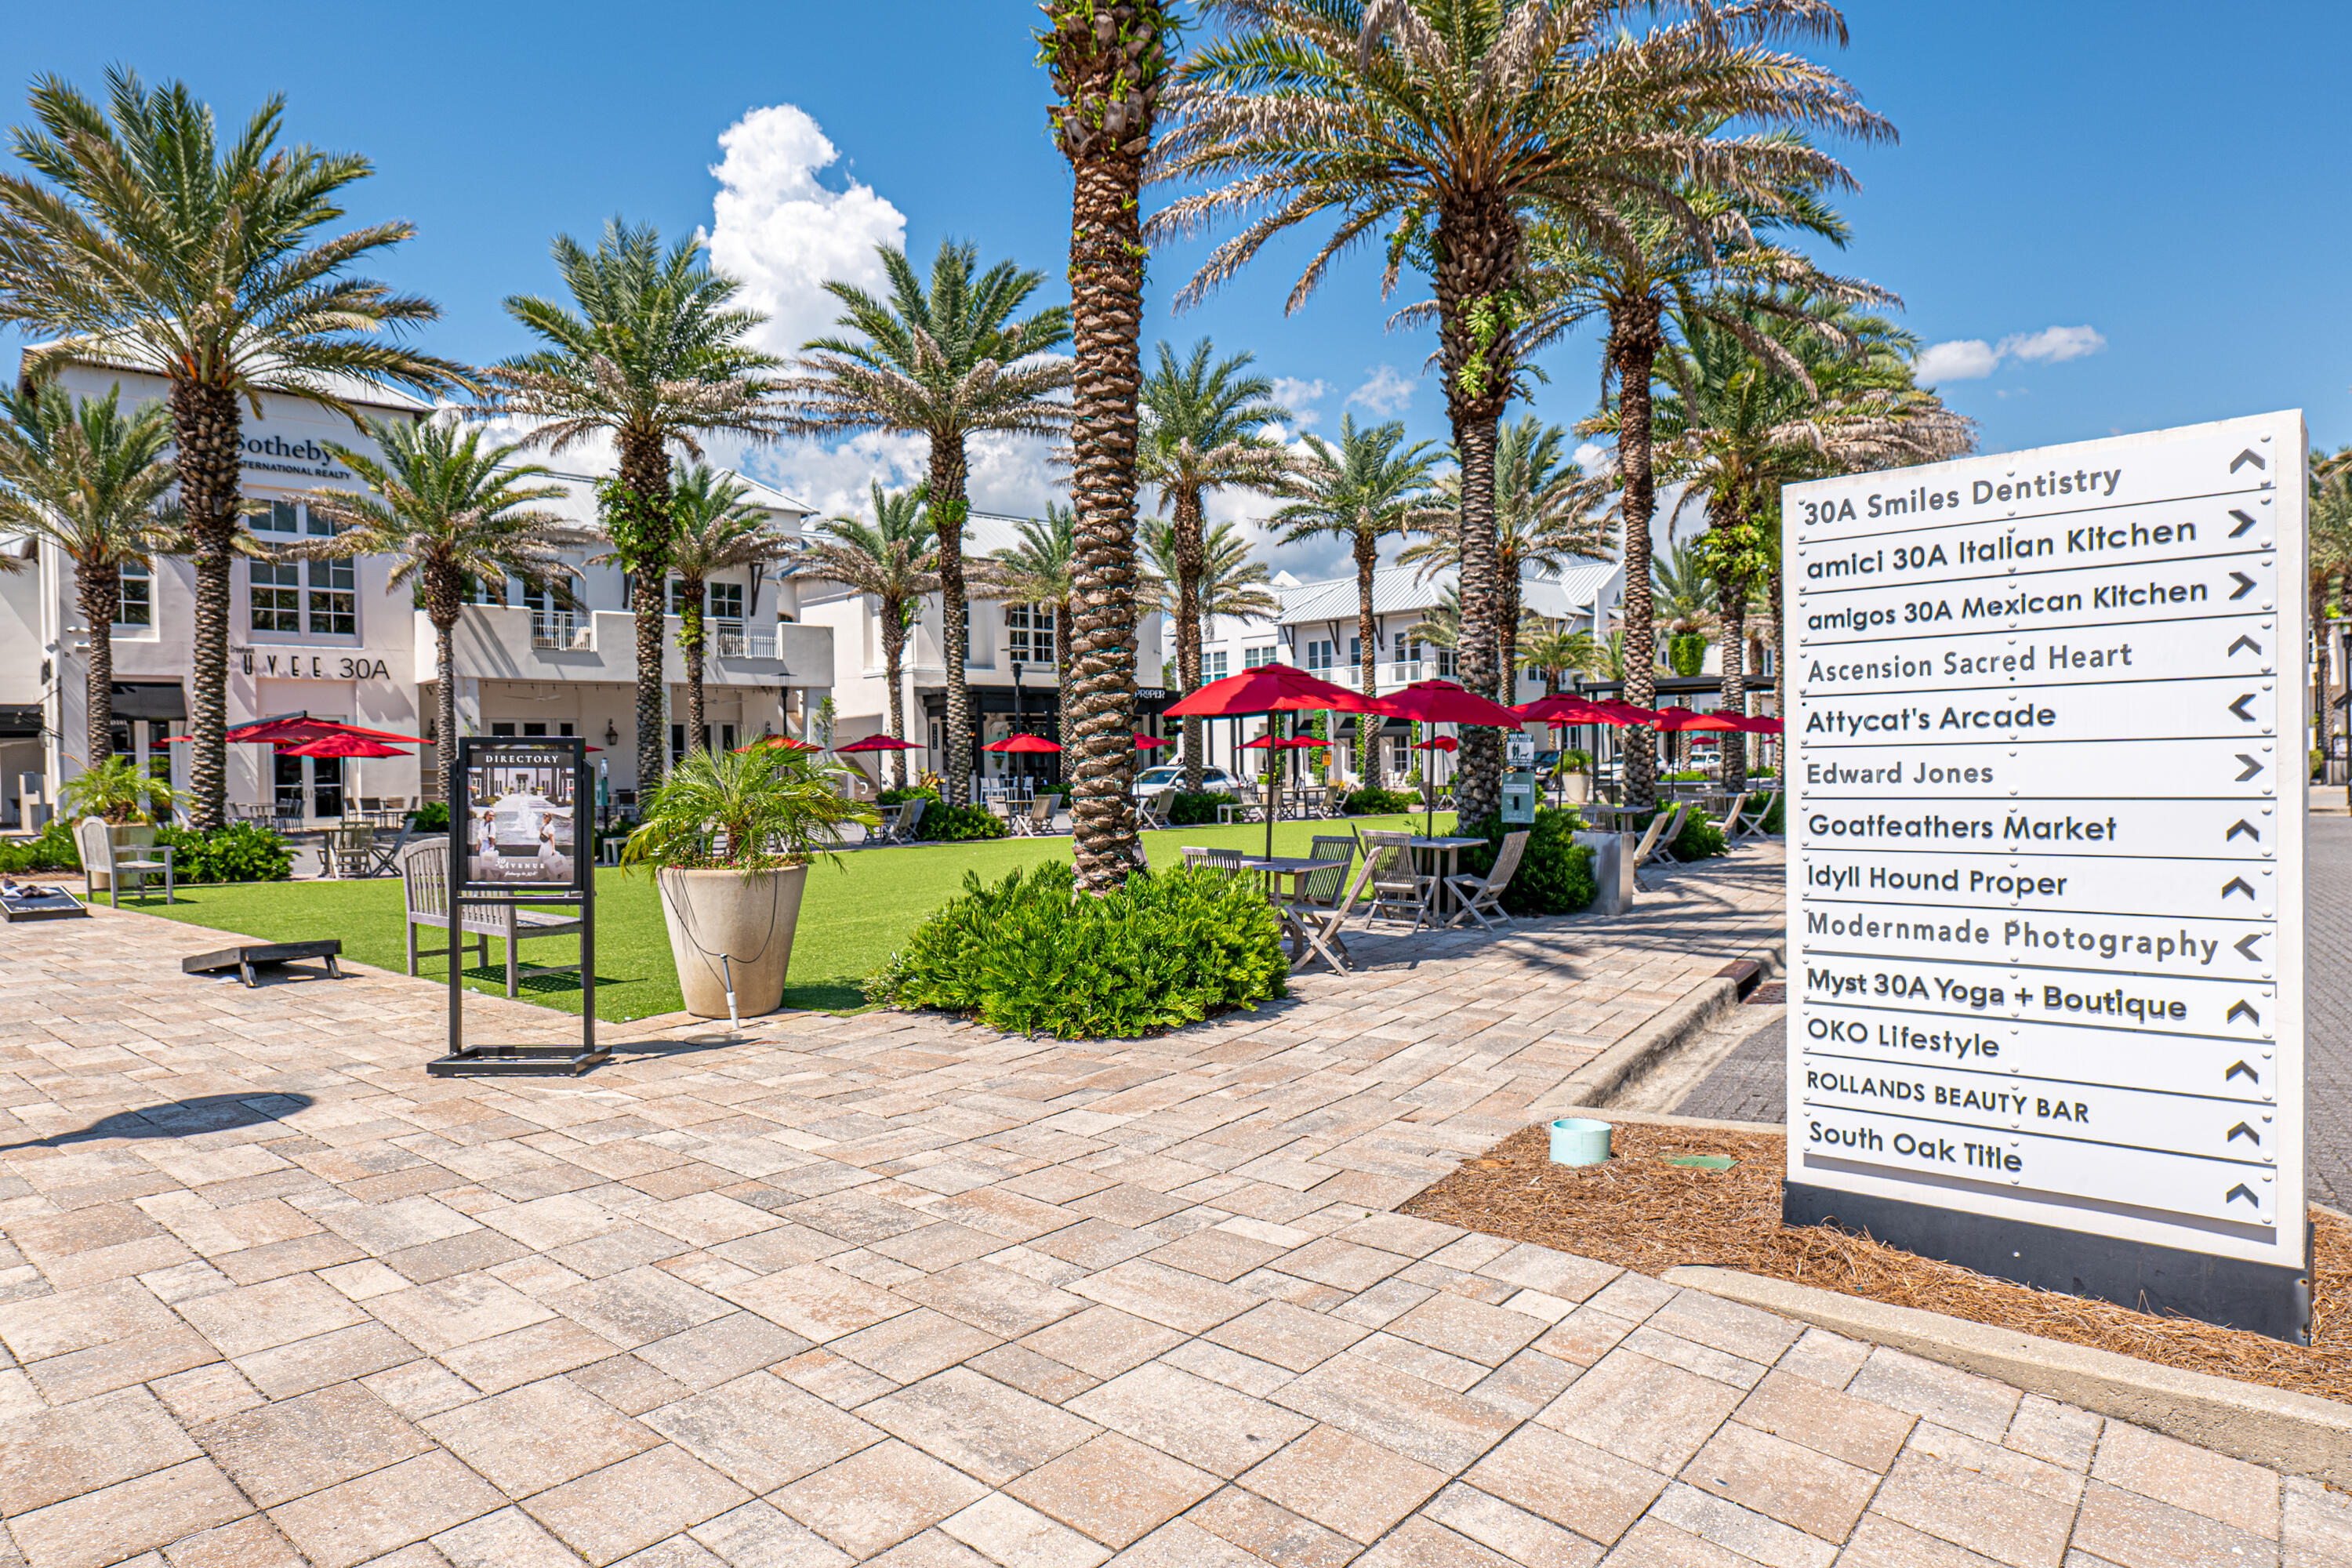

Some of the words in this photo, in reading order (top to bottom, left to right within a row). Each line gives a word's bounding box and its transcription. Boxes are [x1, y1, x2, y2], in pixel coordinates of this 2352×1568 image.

[238, 460, 313, 476] TERNATIONAL
[315, 469, 351, 480] REALTY
[1805, 499, 1857, 525] 30A
[1868, 487, 1958, 517] Smiles
[1973, 470, 2121, 504] Dentistry
[1807, 550, 1882, 579] amici
[1893, 544, 1947, 570] 30A
[1960, 535, 2053, 564] Italian
[2068, 523, 2196, 553] Kitchen
[1808, 608, 1895, 631] amigos
[1904, 601, 1952, 622] 30A
[1962, 593, 2082, 619] Mexican
[2094, 583, 2207, 608] Kitchen
[339, 658, 390, 681] 30A
[1808, 655, 1931, 682] Ascension
[1944, 646, 2034, 674] Sacred
[2050, 644, 2132, 669] Heart
[1134, 689, 1166, 699] PROPER
[1806, 708, 1929, 736] Attycat's
[1940, 704, 2056, 729] Arcade
[1808, 762, 1901, 783] Edward
[1914, 763, 1993, 783] Jones
[1809, 815, 1993, 838] Goatfeathers
[2004, 816, 2116, 840] Market
[1809, 866, 1859, 890] Idyll
[1871, 867, 1958, 891] Hound
[1971, 870, 2067, 899] Proper
[1809, 913, 1989, 944] Modernmade
[2005, 922, 2218, 964] Photography
[1808, 968, 1866, 997] Myst
[1875, 974, 1929, 1000] 30A
[1934, 978, 2004, 1009] Yoga
[2015, 988, 2033, 1007] +
[2044, 985, 2187, 1022] Boutique
[1808, 1018, 1867, 1044] OKO
[1879, 1025, 1999, 1058] Lifestyle
[1807, 1071, 1925, 1102] ROLLANDS
[1936, 1086, 2027, 1115] BEAUTY
[2038, 1098, 2089, 1123] BAR
[1809, 1121, 1882, 1151] South
[1894, 1134, 1955, 1162] Oak
[1964, 1143, 2022, 1172] Title
